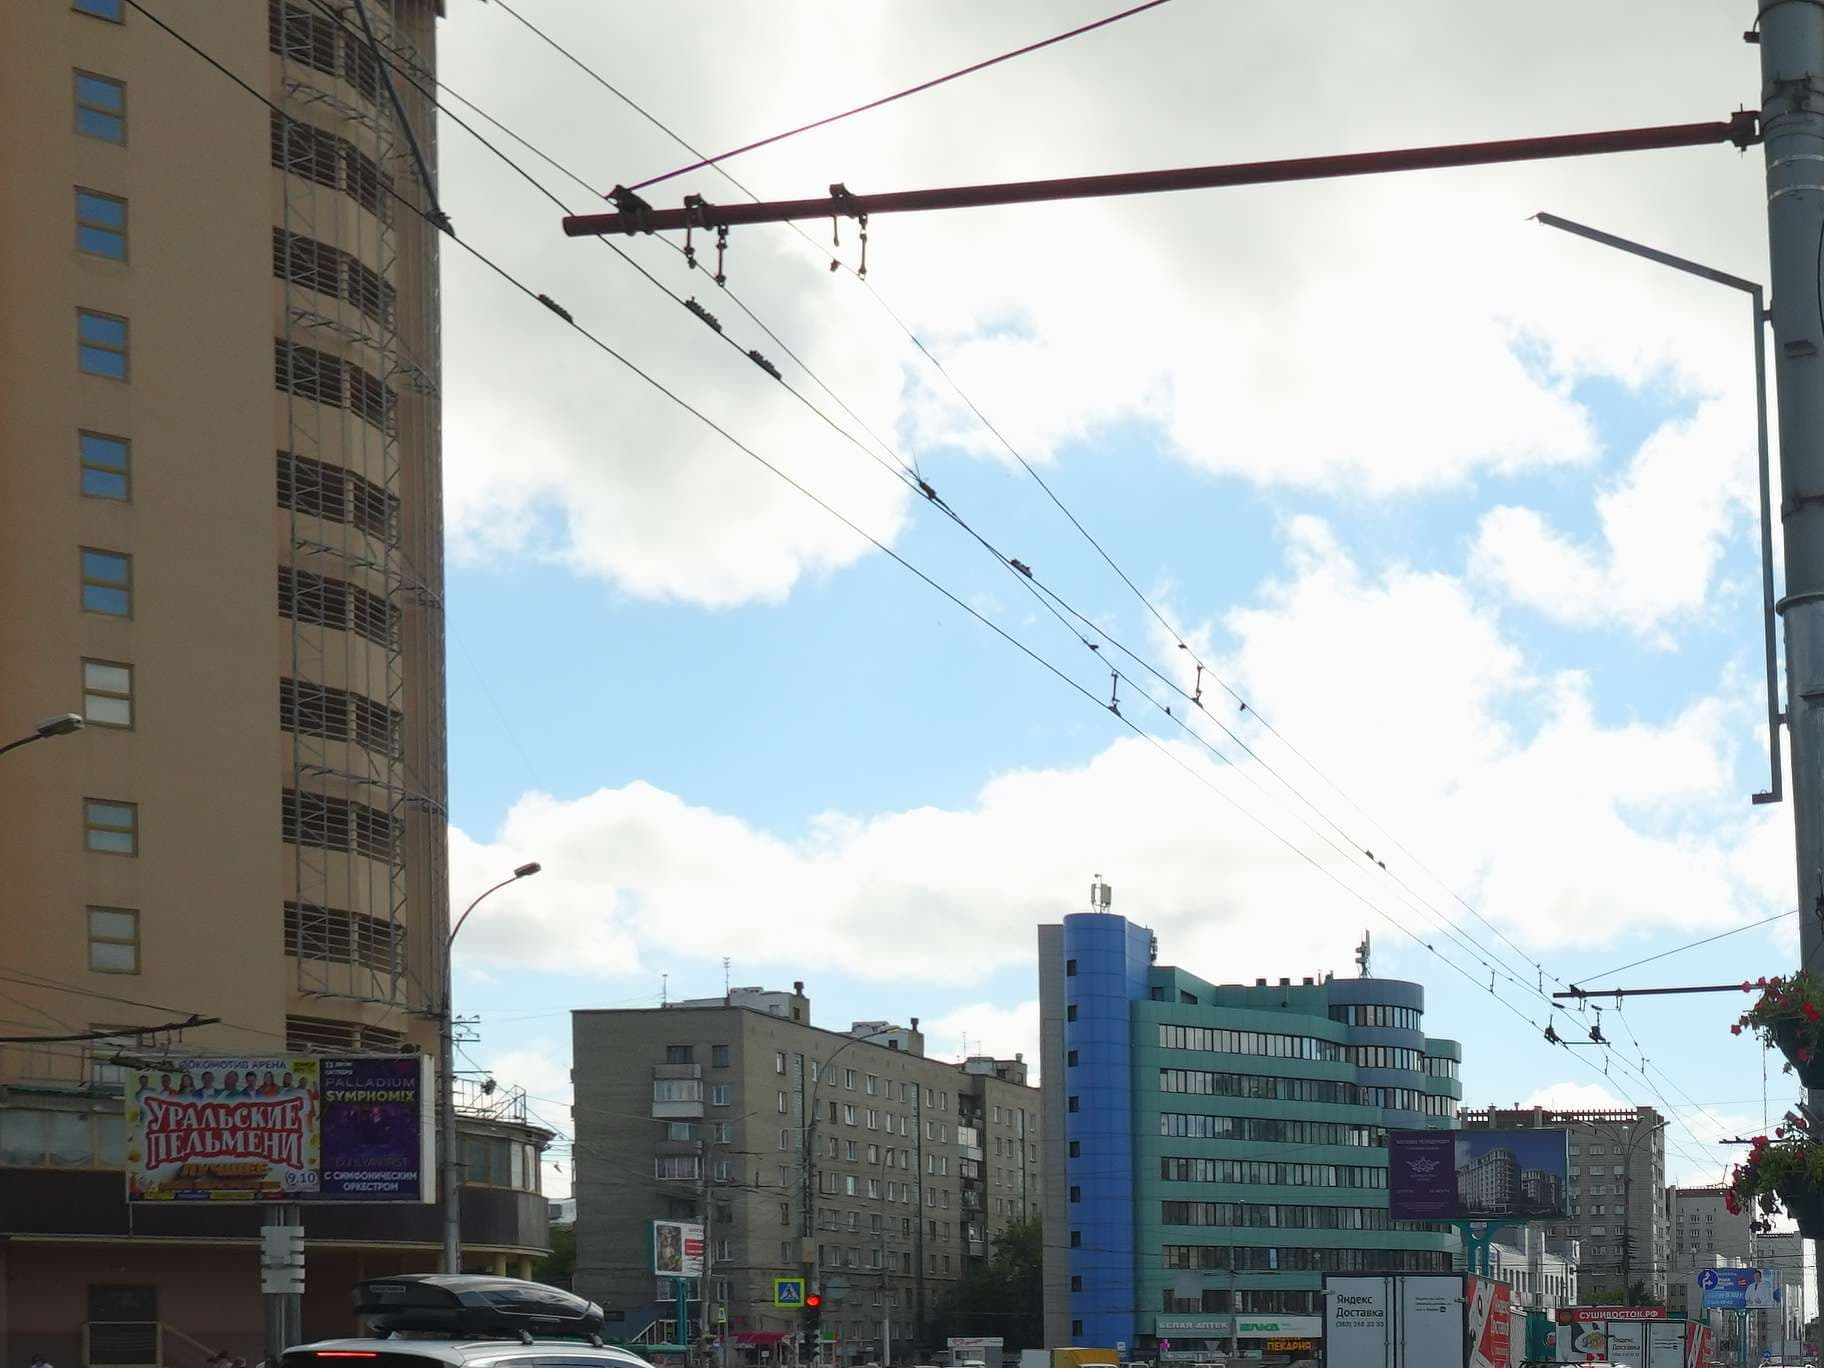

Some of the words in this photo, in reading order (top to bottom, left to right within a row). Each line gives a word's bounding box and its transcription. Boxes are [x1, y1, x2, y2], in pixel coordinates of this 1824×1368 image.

[326, 1078, 416, 1088] PALLADIUM
[326, 1090, 416, 1102] SYMPHOMIX
[149, 1100, 301, 1130] УРАЛЬСКИЕ
[149, 1130, 302, 1166] ПЕЛЬМЕНИ
[288, 1173, 317, 1184] 9.10
[333, 1171, 417, 1180] СИМФОНИЧЕСКИМ
[343, 1182, 399, 1192] ОРКЕСТРОМ
[1337, 1295, 1373, 1305] Яндекс
[1336, 1307, 1384, 1318] Доставка
[1579, 1310, 1659, 1319] СУШИВОСТОК.РФ
[1267, 1342, 1313, 1350] ПЕКАРНЯ
